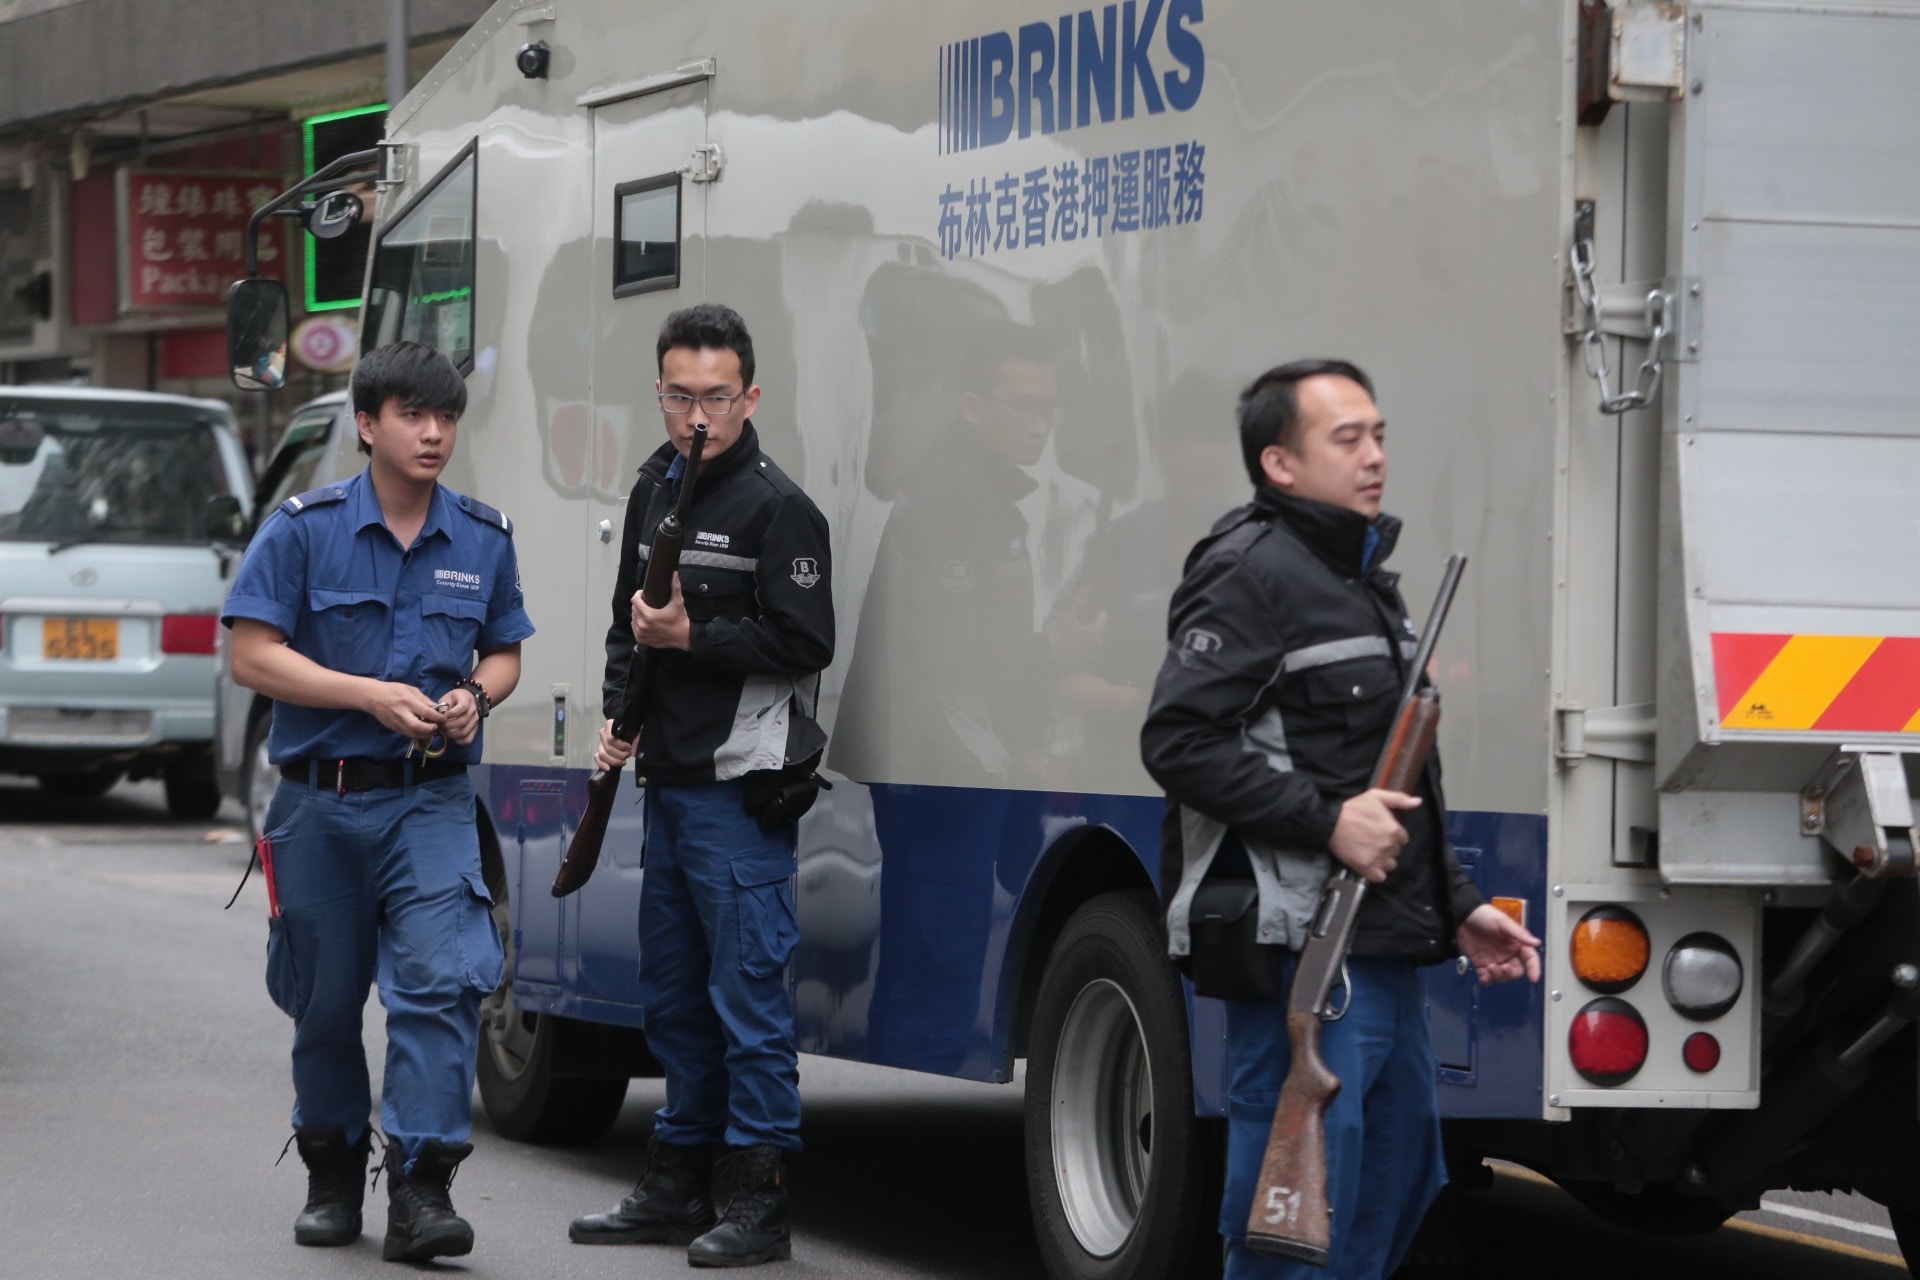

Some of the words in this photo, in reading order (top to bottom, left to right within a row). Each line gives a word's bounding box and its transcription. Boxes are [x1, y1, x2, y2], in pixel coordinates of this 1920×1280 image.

[979, 0, 1205, 148] BRINKS
[938, 140, 1205, 261] 布林克香港押運服務
[702, 532, 730, 544] BRINKS
[443, 570, 480, 585] BRINKS
[1265, 1186, 1301, 1229] 51
